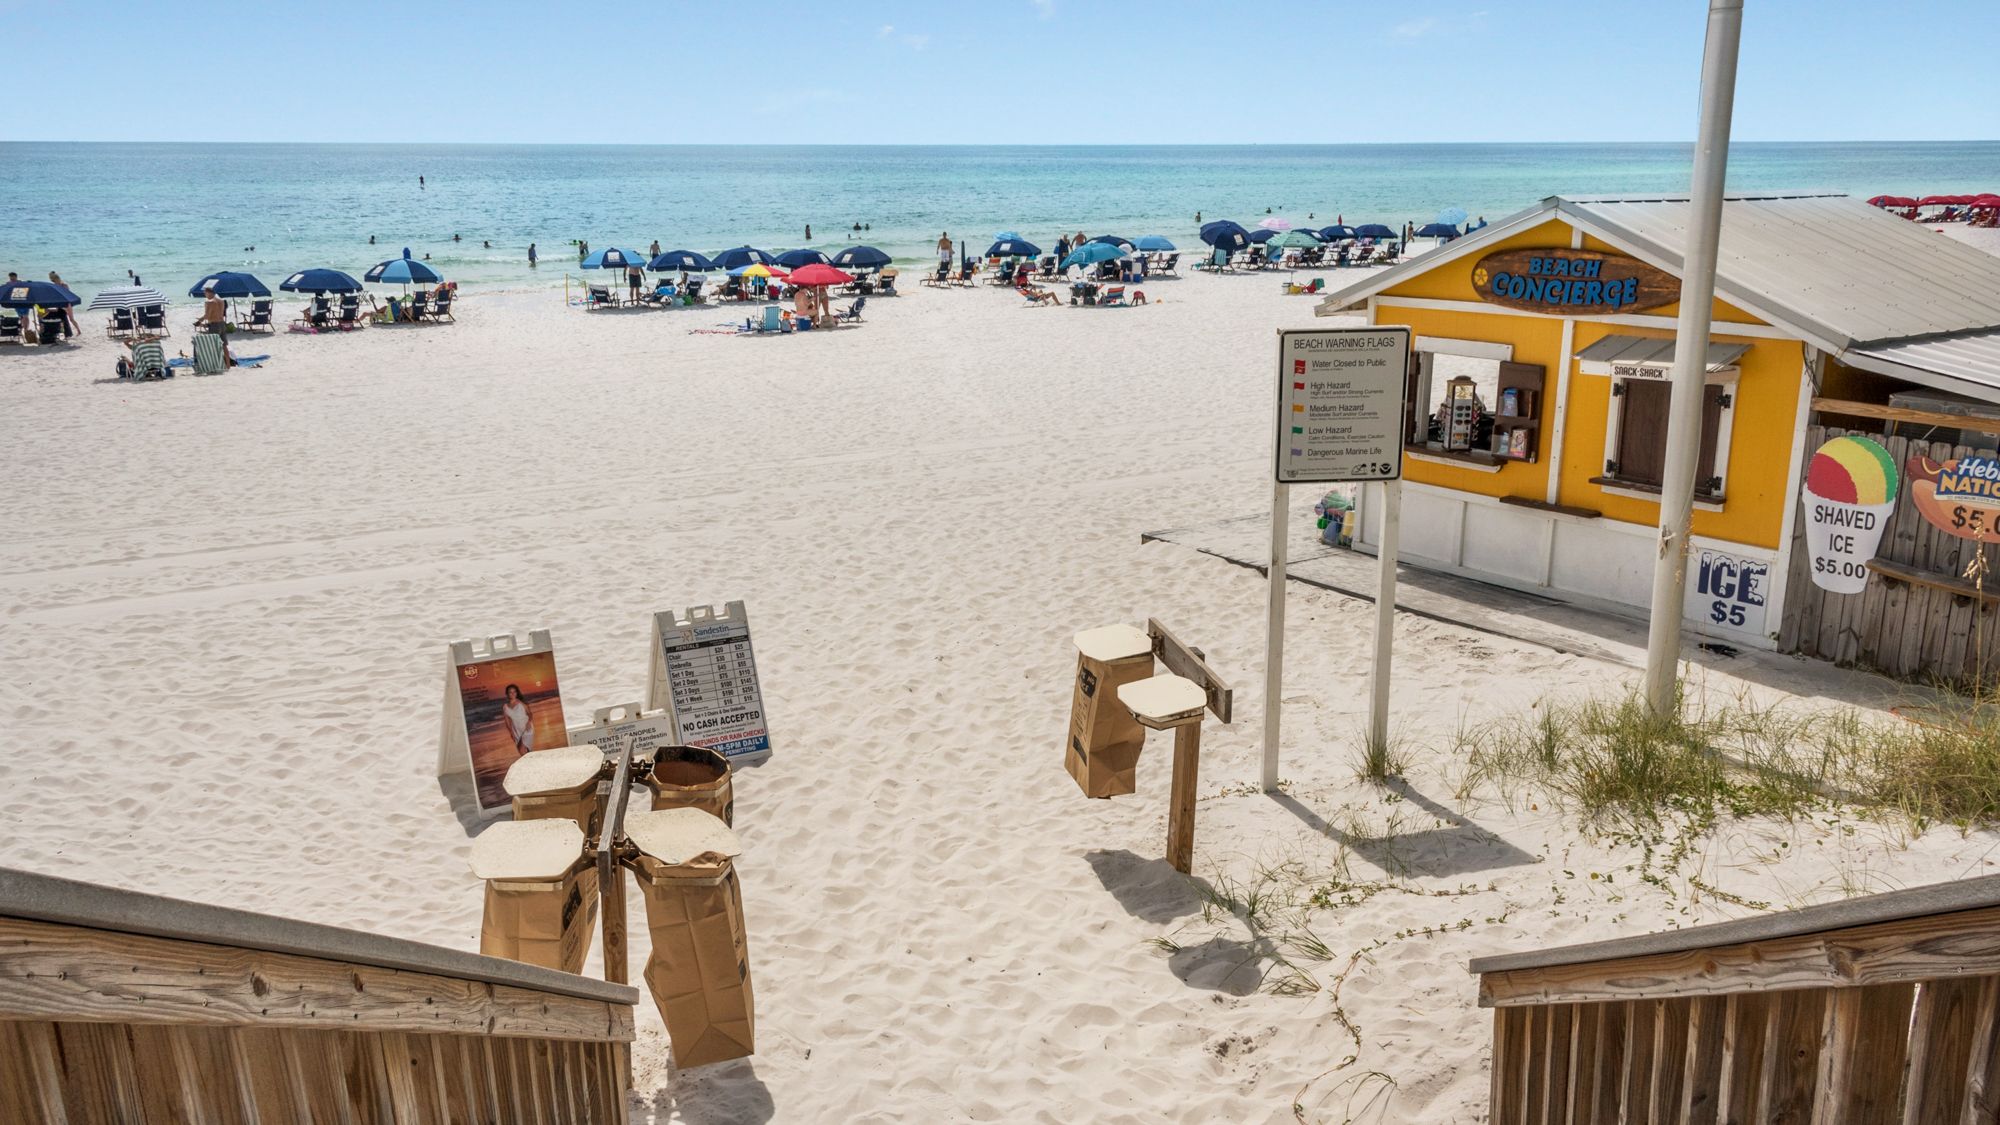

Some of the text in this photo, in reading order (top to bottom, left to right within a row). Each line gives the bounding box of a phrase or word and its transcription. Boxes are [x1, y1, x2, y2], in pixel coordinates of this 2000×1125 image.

[1529, 257, 1602, 278] BEACH
[1492, 272, 1639, 309] CONCIERGE
[1294, 337, 1395, 349] BEACH WARNING FLAGS
[1310, 382, 1325, 391] High
[1308, 449, 1344, 457] Dangerous
[1815, 505, 1875, 530] SHAVED
[1829, 534, 1854, 554] ICE
[1815, 556, 1865, 579] $5.00
[1698, 552, 1768, 606] ICE
[1711, 600, 1746, 626] $5
[693, 624, 730, 637] Sandestin
[683, 723, 694, 732] NO
[697, 719, 718, 730] CASH
[720, 711, 760, 724] ACCEPTED
[599, 736, 619, 744] TENTS
[640, 733, 667, 741] Sandestin
[694, 736, 719, 747] REFUNDS
[729, 732, 742, 740] RAIN
[743, 728, 764, 738] CHECKS
[743, 737, 764, 746] DAILY
[726, 746, 756, 755] PERMITTING
